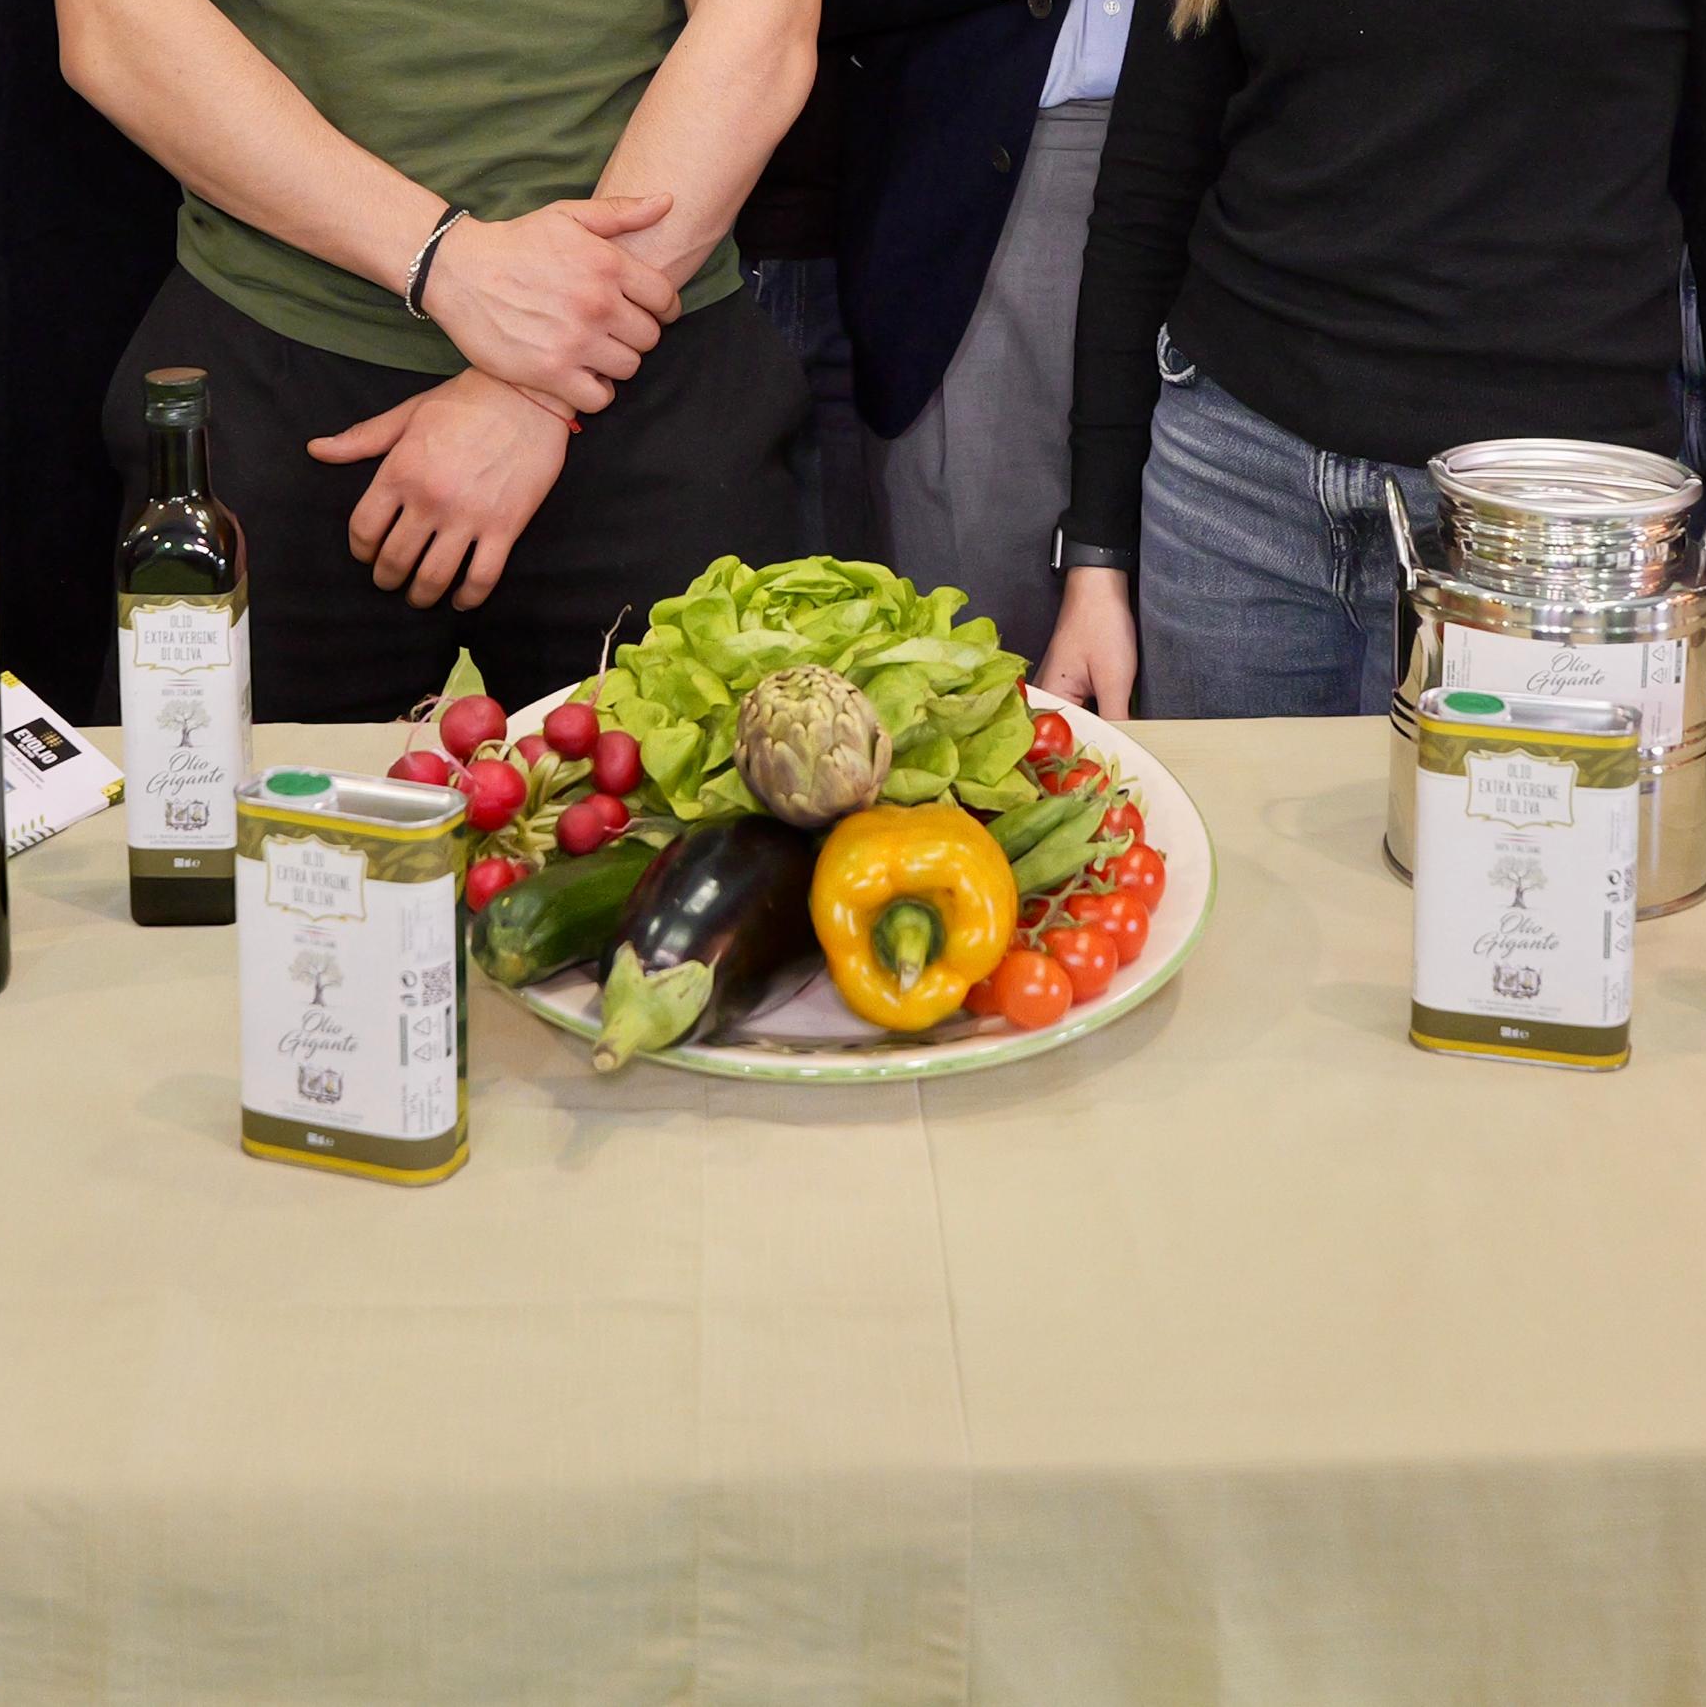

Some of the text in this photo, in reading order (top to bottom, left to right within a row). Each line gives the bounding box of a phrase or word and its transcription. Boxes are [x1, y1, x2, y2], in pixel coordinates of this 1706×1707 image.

[170, 614, 192, 628] OLIO
[144, 630, 218, 645] EXTRA VERGINE
[161, 647, 202, 661] DI OLIVA
[1550, 651, 1591, 673] Olio
[1526, 668, 1606, 694] Gigante
[13, 728, 59, 764] EVOLIO
[168, 751, 209, 773] Olio
[1507, 763, 1531, 779] OLIO
[146, 766, 225, 796] Gigante
[1478, 778, 1558, 800] EXTRA VERGINE
[1510, 799, 1540, 814] OLIVA
[1500, 912, 1542, 934] Olio
[1473, 932, 1559, 959] Gigante
